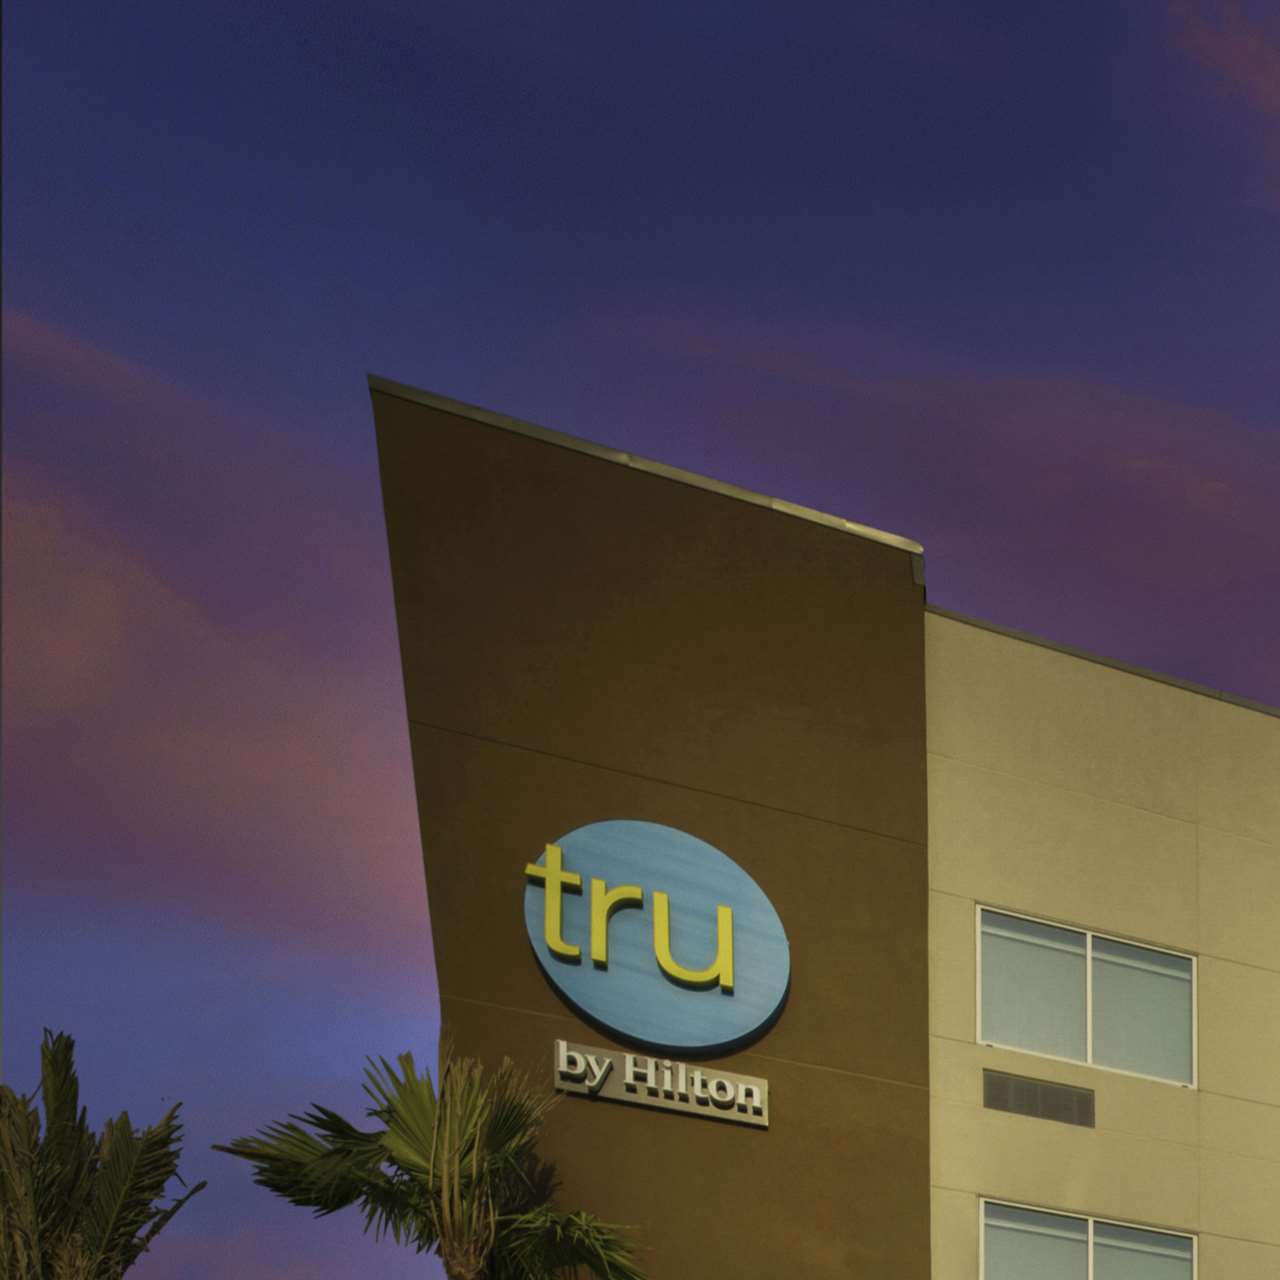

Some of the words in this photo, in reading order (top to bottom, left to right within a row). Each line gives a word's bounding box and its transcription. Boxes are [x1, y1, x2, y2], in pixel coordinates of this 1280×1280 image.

[524, 843, 734, 992] tru
[555, 1039, 612, 1090] by
[624, 1053, 762, 1111] Hilton
